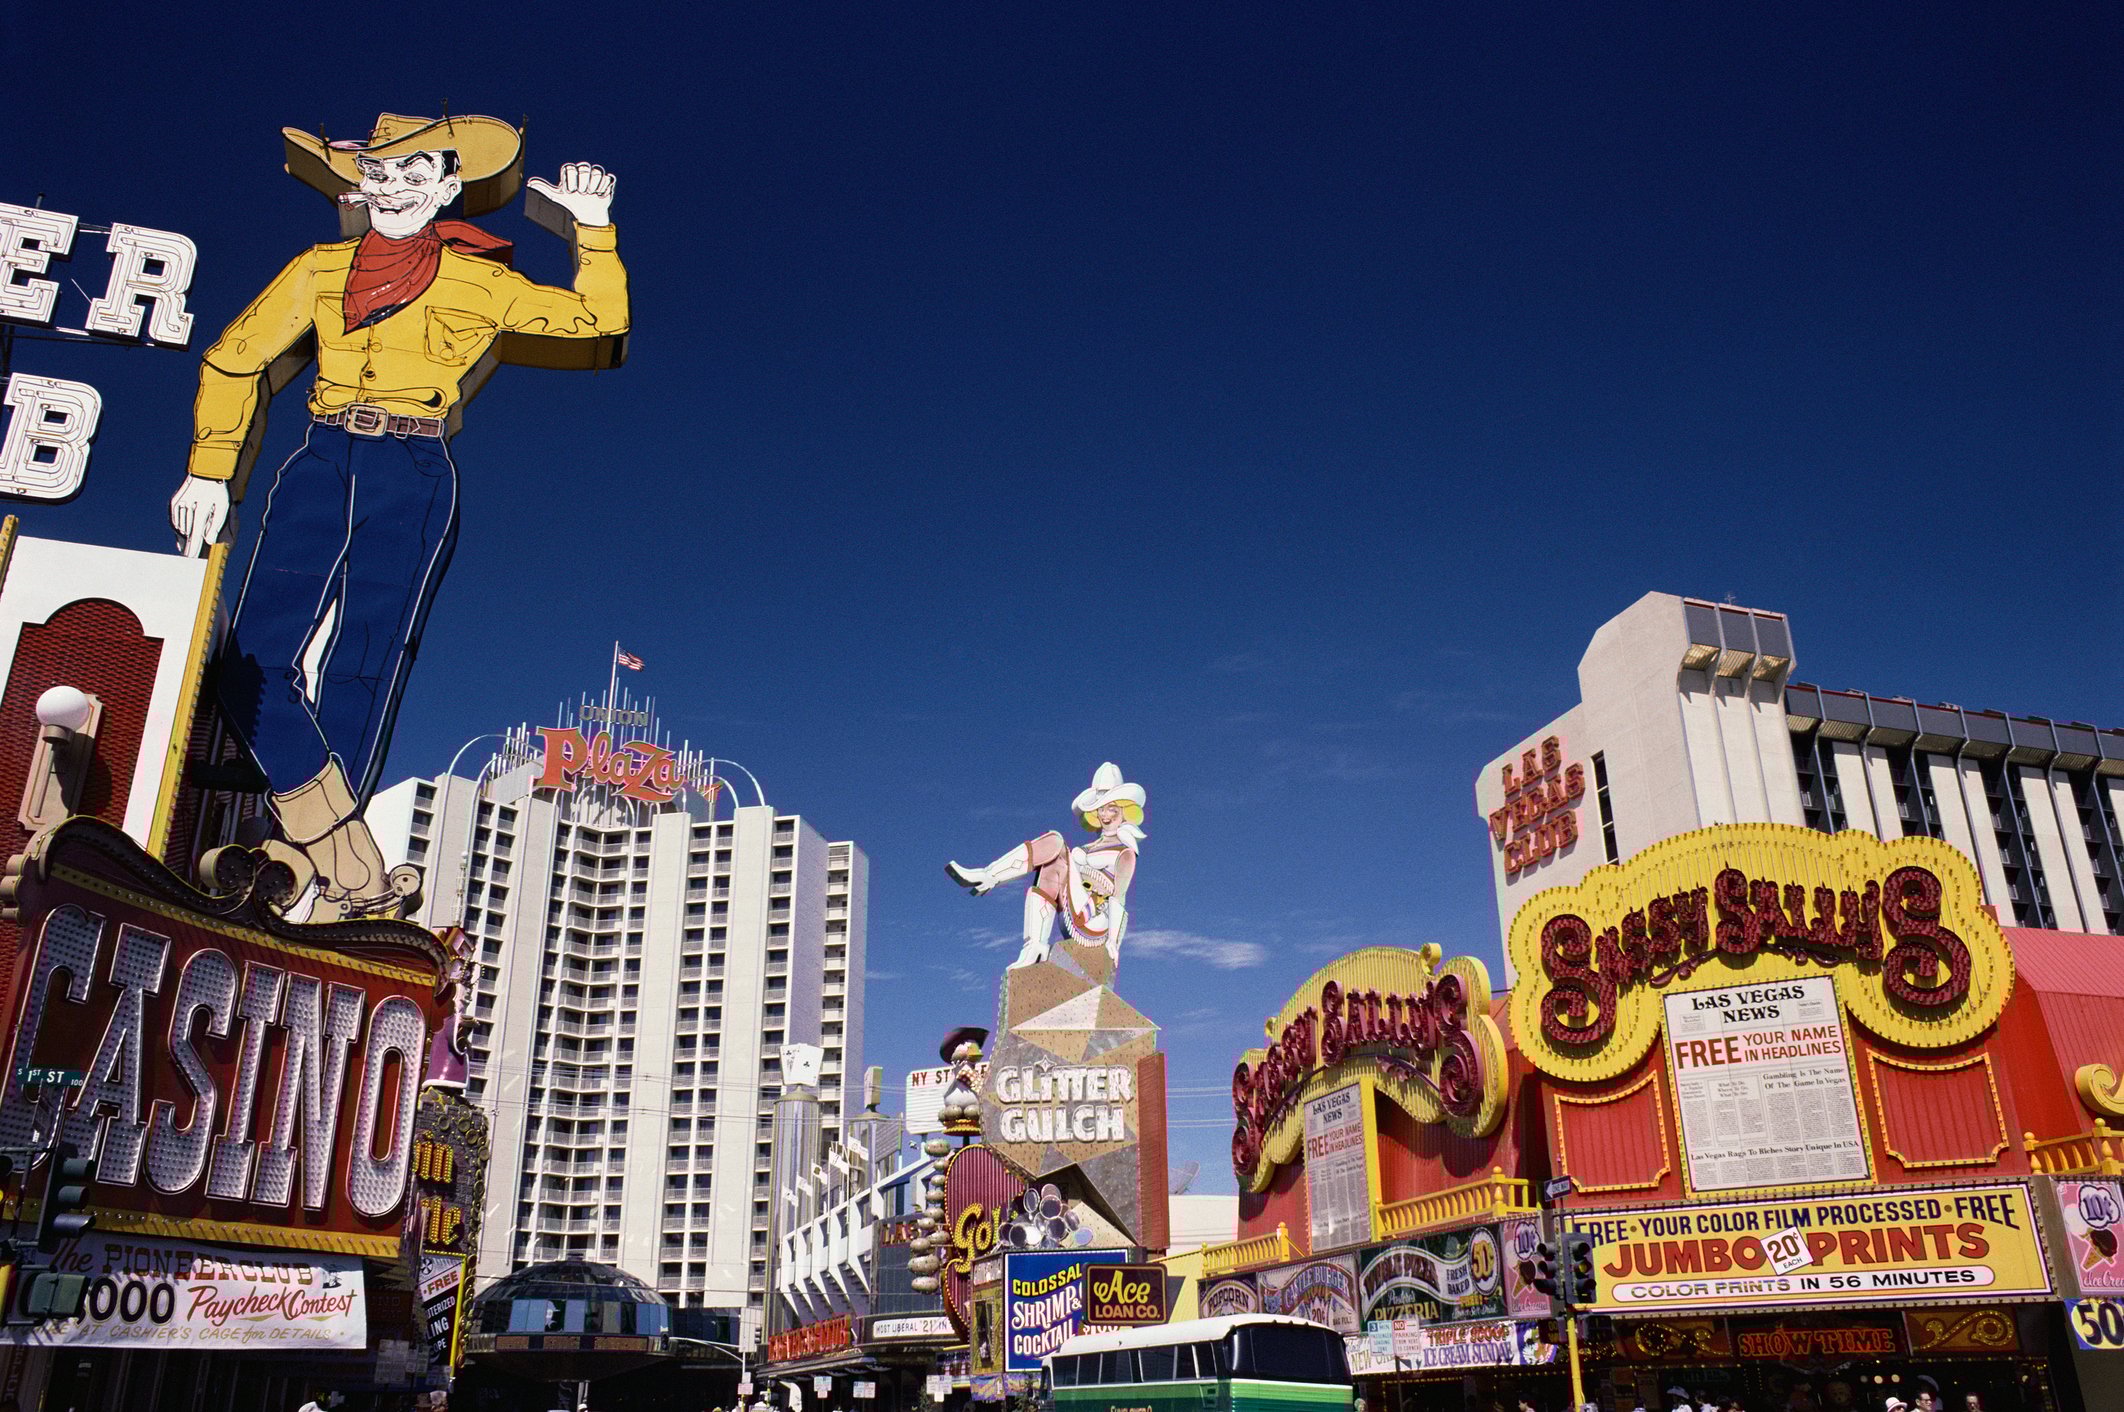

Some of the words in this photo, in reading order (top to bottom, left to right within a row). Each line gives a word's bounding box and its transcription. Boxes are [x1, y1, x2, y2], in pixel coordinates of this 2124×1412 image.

[580, 705, 649, 727] UNION
[533, 726, 686, 803] Plaza
[1502, 735, 1562, 798] LAS
[1490, 763, 1586, 841] VEGAS
[1504, 809, 1579, 875] CLUB
[1692, 993, 1731, 1011] LAS
[1737, 985, 1805, 1005] VEGAS
[1723, 1005, 1780, 1023] NEWS
[1743, 1031, 1785, 1046] YOUR
[1791, 1025, 1838, 1042] NAME
[2, 904, 426, 1217] CASINO
[1675, 1036, 1742, 1069] FREE
[1745, 1049, 1759, 1062] IN
[1762, 1040, 1842, 1061] HEADLINES
[47, 1071, 65, 1083] ST
[912, 1071, 928, 1087] NY
[1763, 1071, 1797, 1080] Gambling
[1800, 1069, 1806, 1077] Is
[1808, 1068, 1821, 1077] The
[1824, 1067, 1845, 1075] Name
[1794, 1079, 1815, 1087] Game
[1824, 1077, 1847, 1086] Vegas
[1312, 1099, 1327, 1115] LAS
[1327, 1092, 1351, 1109] VEGAS
[1000, 1105, 1125, 1143] GULCH
[1323, 1108, 1343, 1124] NEWS
[1329, 1127, 1344, 1139] YOUR
[1345, 1122, 1362, 1136] NAME
[1308, 1134, 1329, 1160] FREE
[1335, 1135, 1363, 1151] HEADLINES
[1691, 1153, 1704, 1161] Las
[1704, 1151, 1726, 1161] Vegas
[1727, 1149, 1747, 1159] Rags
[1747, 1148, 1757, 1156] To
[1759, 1146, 1783, 1155] Riches
[1784, 1145, 1803, 1154] Story
[1805, 1143, 1833, 1153] Unique
[1833, 1141, 1841, 1149] In
[1843, 1140, 1859, 1148] USA
[1639, 1215, 1692, 1236] YOUR
[1697, 1211, 1758, 1233] COLOR
[1764, 1206, 1811, 1230] FILM
[1816, 1199, 1941, 1226] PROCESSED
[1954, 1194, 2021, 1230] FREE
[1603, 1235, 1768, 1278] JUMBO
[1806, 1222, 1990, 1266] PRINTS
[1767, 1231, 1801, 1264] 20¢
[1446, 1265, 1468, 1282] FRESH
[1783, 1256, 1803, 1270] EACH
[427, 1271, 459, 1295] FREE
[1012, 1262, 1083, 1297] COLOSSAL
[1093, 1270, 1151, 1304] Ace
[1447, 1278, 1470, 1295] BAKED
[1631, 1281, 1709, 1299] COLOR
[1715, 1279, 1791, 1294] PRINTS
[1801, 1277, 1820, 1289] IN
[1830, 1275, 1861, 1288] 56
[1872, 1270, 1975, 1287] MINUTES
[187, 1285, 292, 1326] Paycheck
[288, 1288, 358, 1320] Contest
[1011, 1285, 1077, 1330] SHRIMP
[1095, 1305, 1134, 1319] LOAN
[1136, 1304, 1161, 1319] CO.
[1208, 1286, 1250, 1314] POPCORN
[1374, 1301, 1439, 1321] PIZZERIA
[110, 1325, 192, 1340] CASHIER'S
[199, 1327, 243, 1340] CAGE
[242, 1325, 266, 1344] for
[269, 1327, 331, 1340] DETAILS
[1394, 1321, 1405, 1329] NO
[1426, 1327, 1467, 1347] TRIPLE
[1470, 1325, 1510, 1343] SCOOP
[1013, 1319, 1076, 1355] COCKTAIL
[1423, 1347, 1438, 1368] ICE
[1439, 1343, 1471, 1367] CREAM
[1472, 1341, 1515, 1366] SUNDAE
